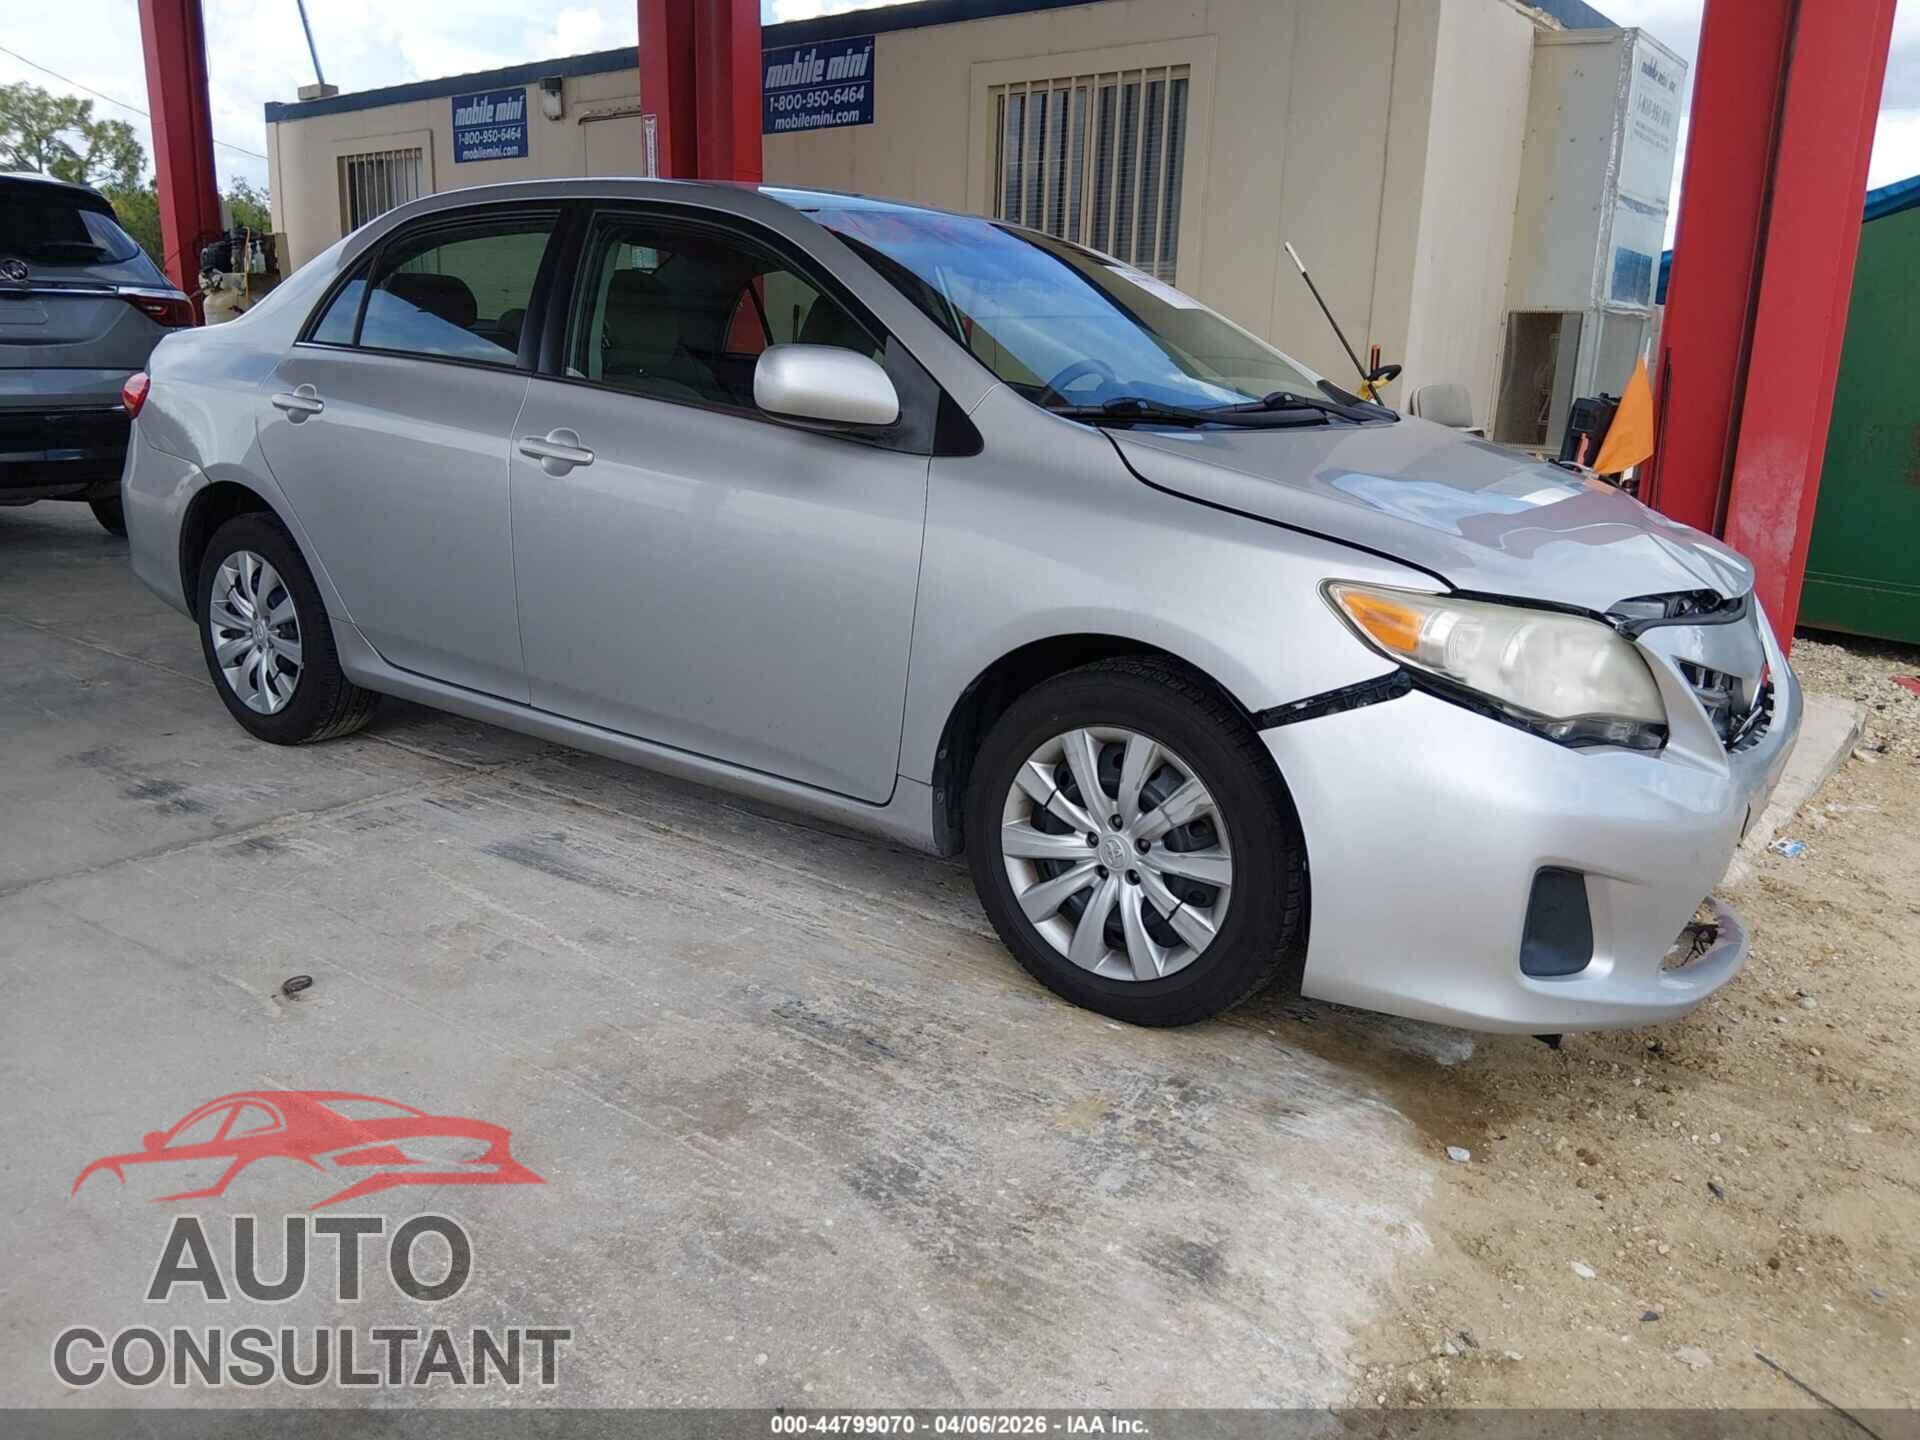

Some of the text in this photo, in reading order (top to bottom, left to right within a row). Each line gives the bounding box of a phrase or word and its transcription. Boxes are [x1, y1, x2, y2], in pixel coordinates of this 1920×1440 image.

[765, 46, 871, 88] mobile mini
[455, 94, 526, 127] mobile mini
[769, 85, 865, 113] 1-800-950-6464
[775, 109, 860, 130] mobilemini.com
